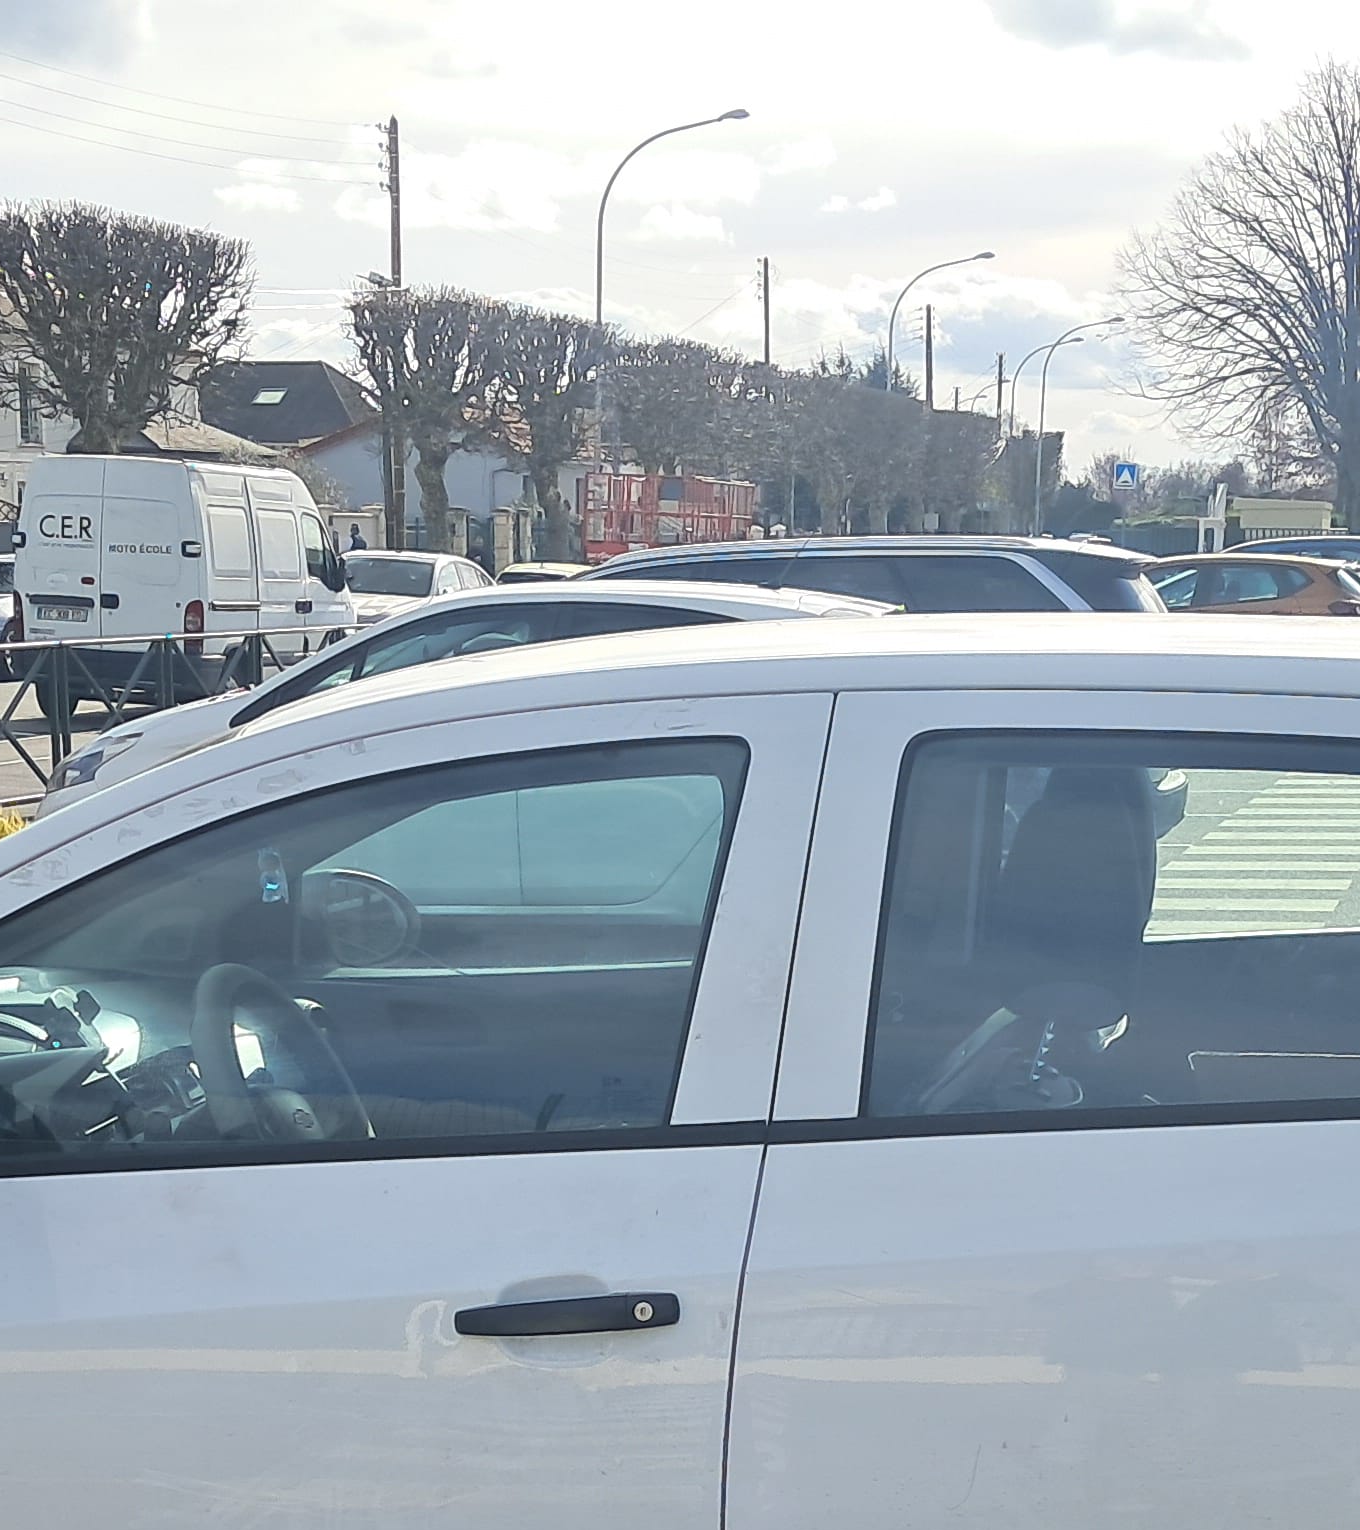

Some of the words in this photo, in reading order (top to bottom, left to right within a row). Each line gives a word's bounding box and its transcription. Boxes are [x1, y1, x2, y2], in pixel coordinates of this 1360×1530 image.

[40, 514, 93, 540] C.E.R
[108, 544, 137, 554] MOTO
[139, 542, 172, 555] ÉCOLE
